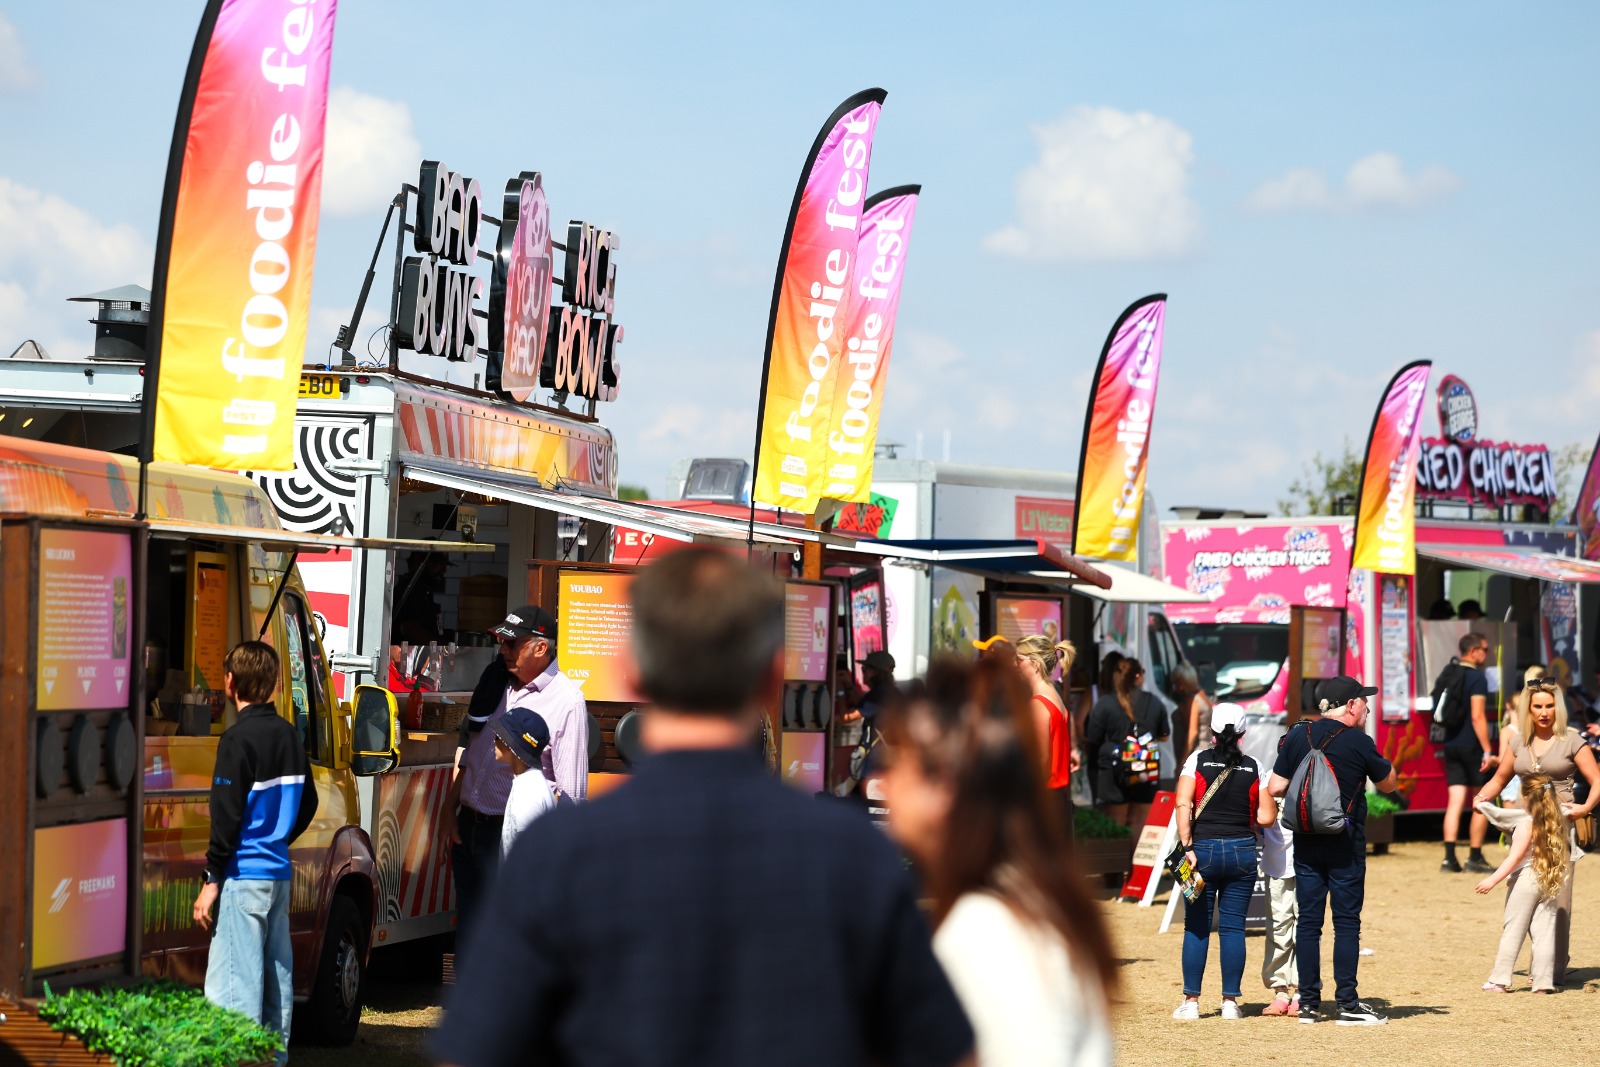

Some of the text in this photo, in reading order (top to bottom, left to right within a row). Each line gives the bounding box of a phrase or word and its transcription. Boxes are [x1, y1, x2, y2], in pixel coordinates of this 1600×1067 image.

[221, 113, 301, 382] foodie
[261, 0, 317, 92] fe
[431, 160, 483, 266] BAO
[413, 257, 484, 362] BUNS
[516, 263, 544, 319] YOU
[575, 221, 620, 314] RICE
[786, 249, 850, 443] foodie
[825, 112, 870, 232] fest
[510, 321, 537, 376] BAO
[555, 307, 624, 402] BOWLS
[829, 214, 904, 455] foodie fest
[1112, 399, 1150, 519] foodie
[570, 584, 602, 594] YOUBAO
[1195, 550, 1331, 567] FRIED CHICKEN TRUCK
[567, 669, 590, 678] CANS
[1203, 762, 1254, 773] PORCHE
[79, 875, 115, 895] FREEMANS
